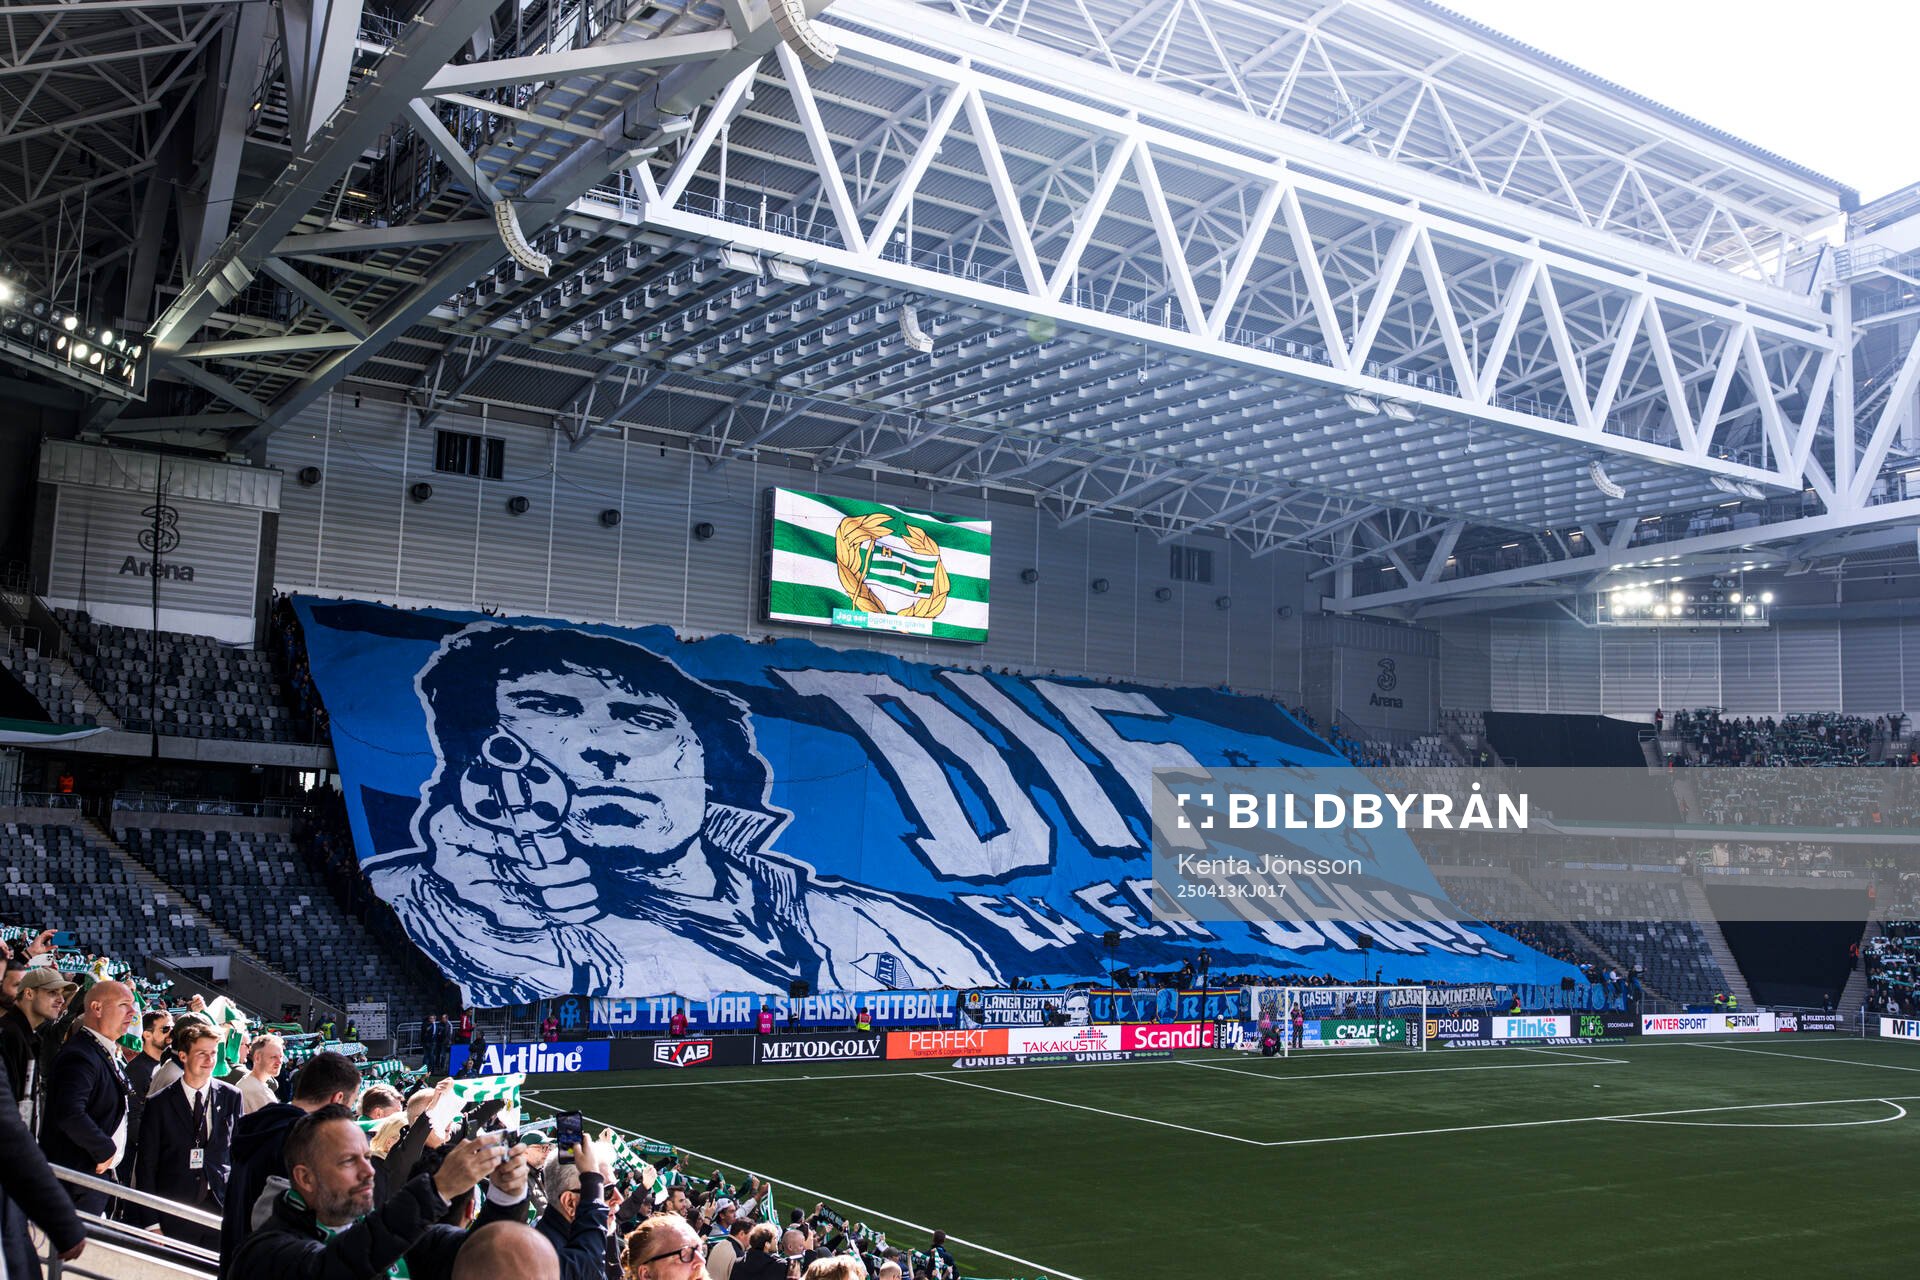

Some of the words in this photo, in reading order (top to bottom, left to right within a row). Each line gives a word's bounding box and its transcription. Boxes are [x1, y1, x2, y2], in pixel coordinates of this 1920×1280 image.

[119, 556, 194, 581] Arena
[1369, 693, 1403, 708] Arena
[771, 668, 1212, 877] DIF
[593, 999, 637, 1024] NEJ
[646, 998, 697, 1024] TILL
[707, 997, 750, 1023] VAR
[775, 994, 858, 1021] SVENSK
[864, 993, 952, 1020] FOTBOLL
[984, 995, 1021, 1009] LÅNGA
[1438, 1019, 1479, 1033] PROJOB
[1507, 1018, 1556, 1037] Flinks
[1653, 1018, 1707, 1031] INTERSPORT
[1738, 1015, 1759, 1027] FRONT
[1135, 1024, 1211, 1049] Scandic
[1336, 1024, 1385, 1038] CRAFT
[909, 1029, 988, 1050] PERFEKT
[1023, 1039, 1107, 1053] TAKAKUSTIK
[1456, 1039, 1507, 1047] UNIBET
[1547, 1037, 1593, 1045] UNIBET
[658, 1044, 709, 1066] EXAB
[761, 1039, 880, 1059] METODGOLV
[479, 1043, 582, 1074] Artline
[965, 1055, 1027, 1067] UNIBET
[1075, 1051, 1132, 1062] UNIBET
